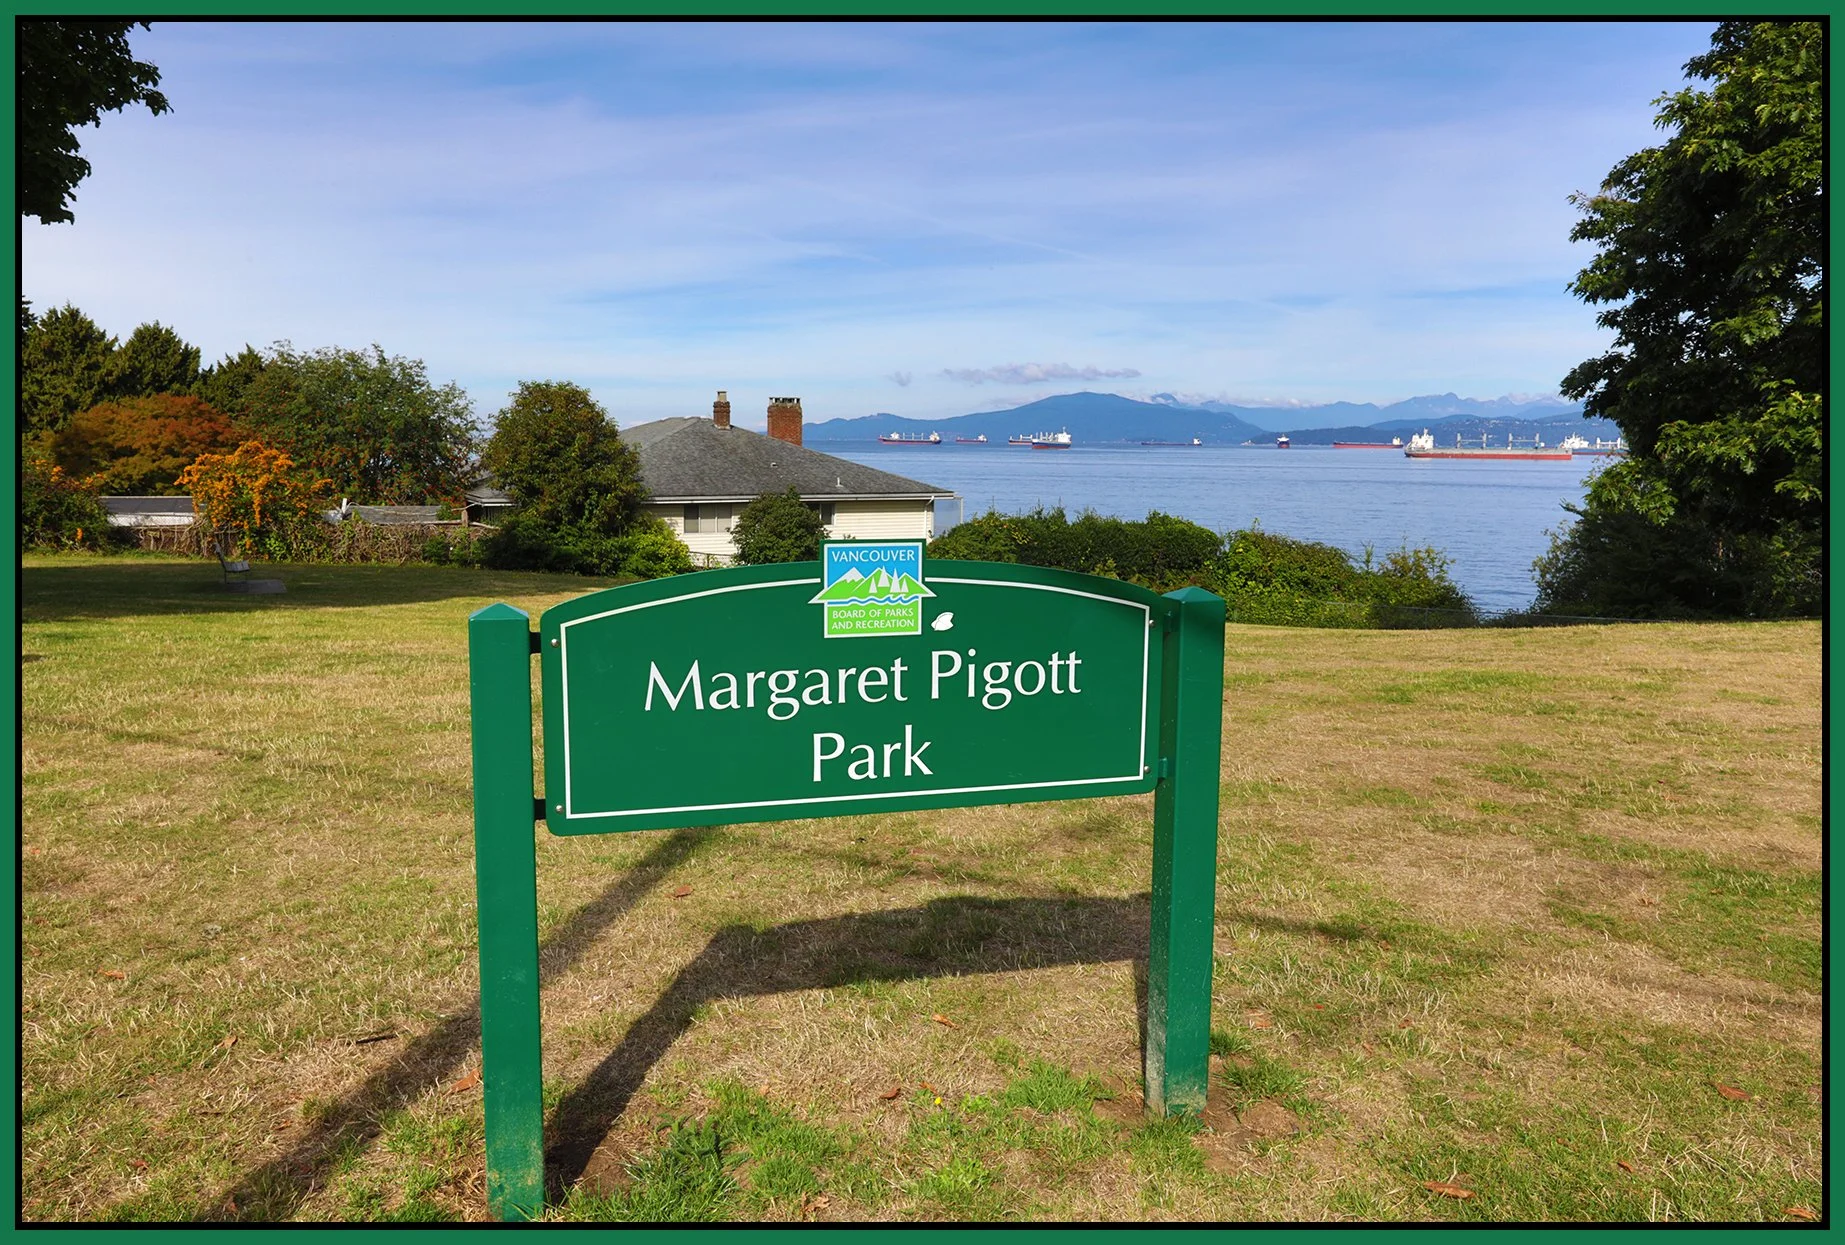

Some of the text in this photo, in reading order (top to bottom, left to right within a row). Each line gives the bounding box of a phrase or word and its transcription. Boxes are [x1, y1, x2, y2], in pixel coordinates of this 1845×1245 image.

[831, 550, 915, 562] VANCOUVER
[832, 607, 914, 619] BOARD OF PARKS
[831, 619, 915, 630] AND RECREATION
[645, 649, 1081, 720] Margaret Pigott
[814, 725, 933, 781] Park
